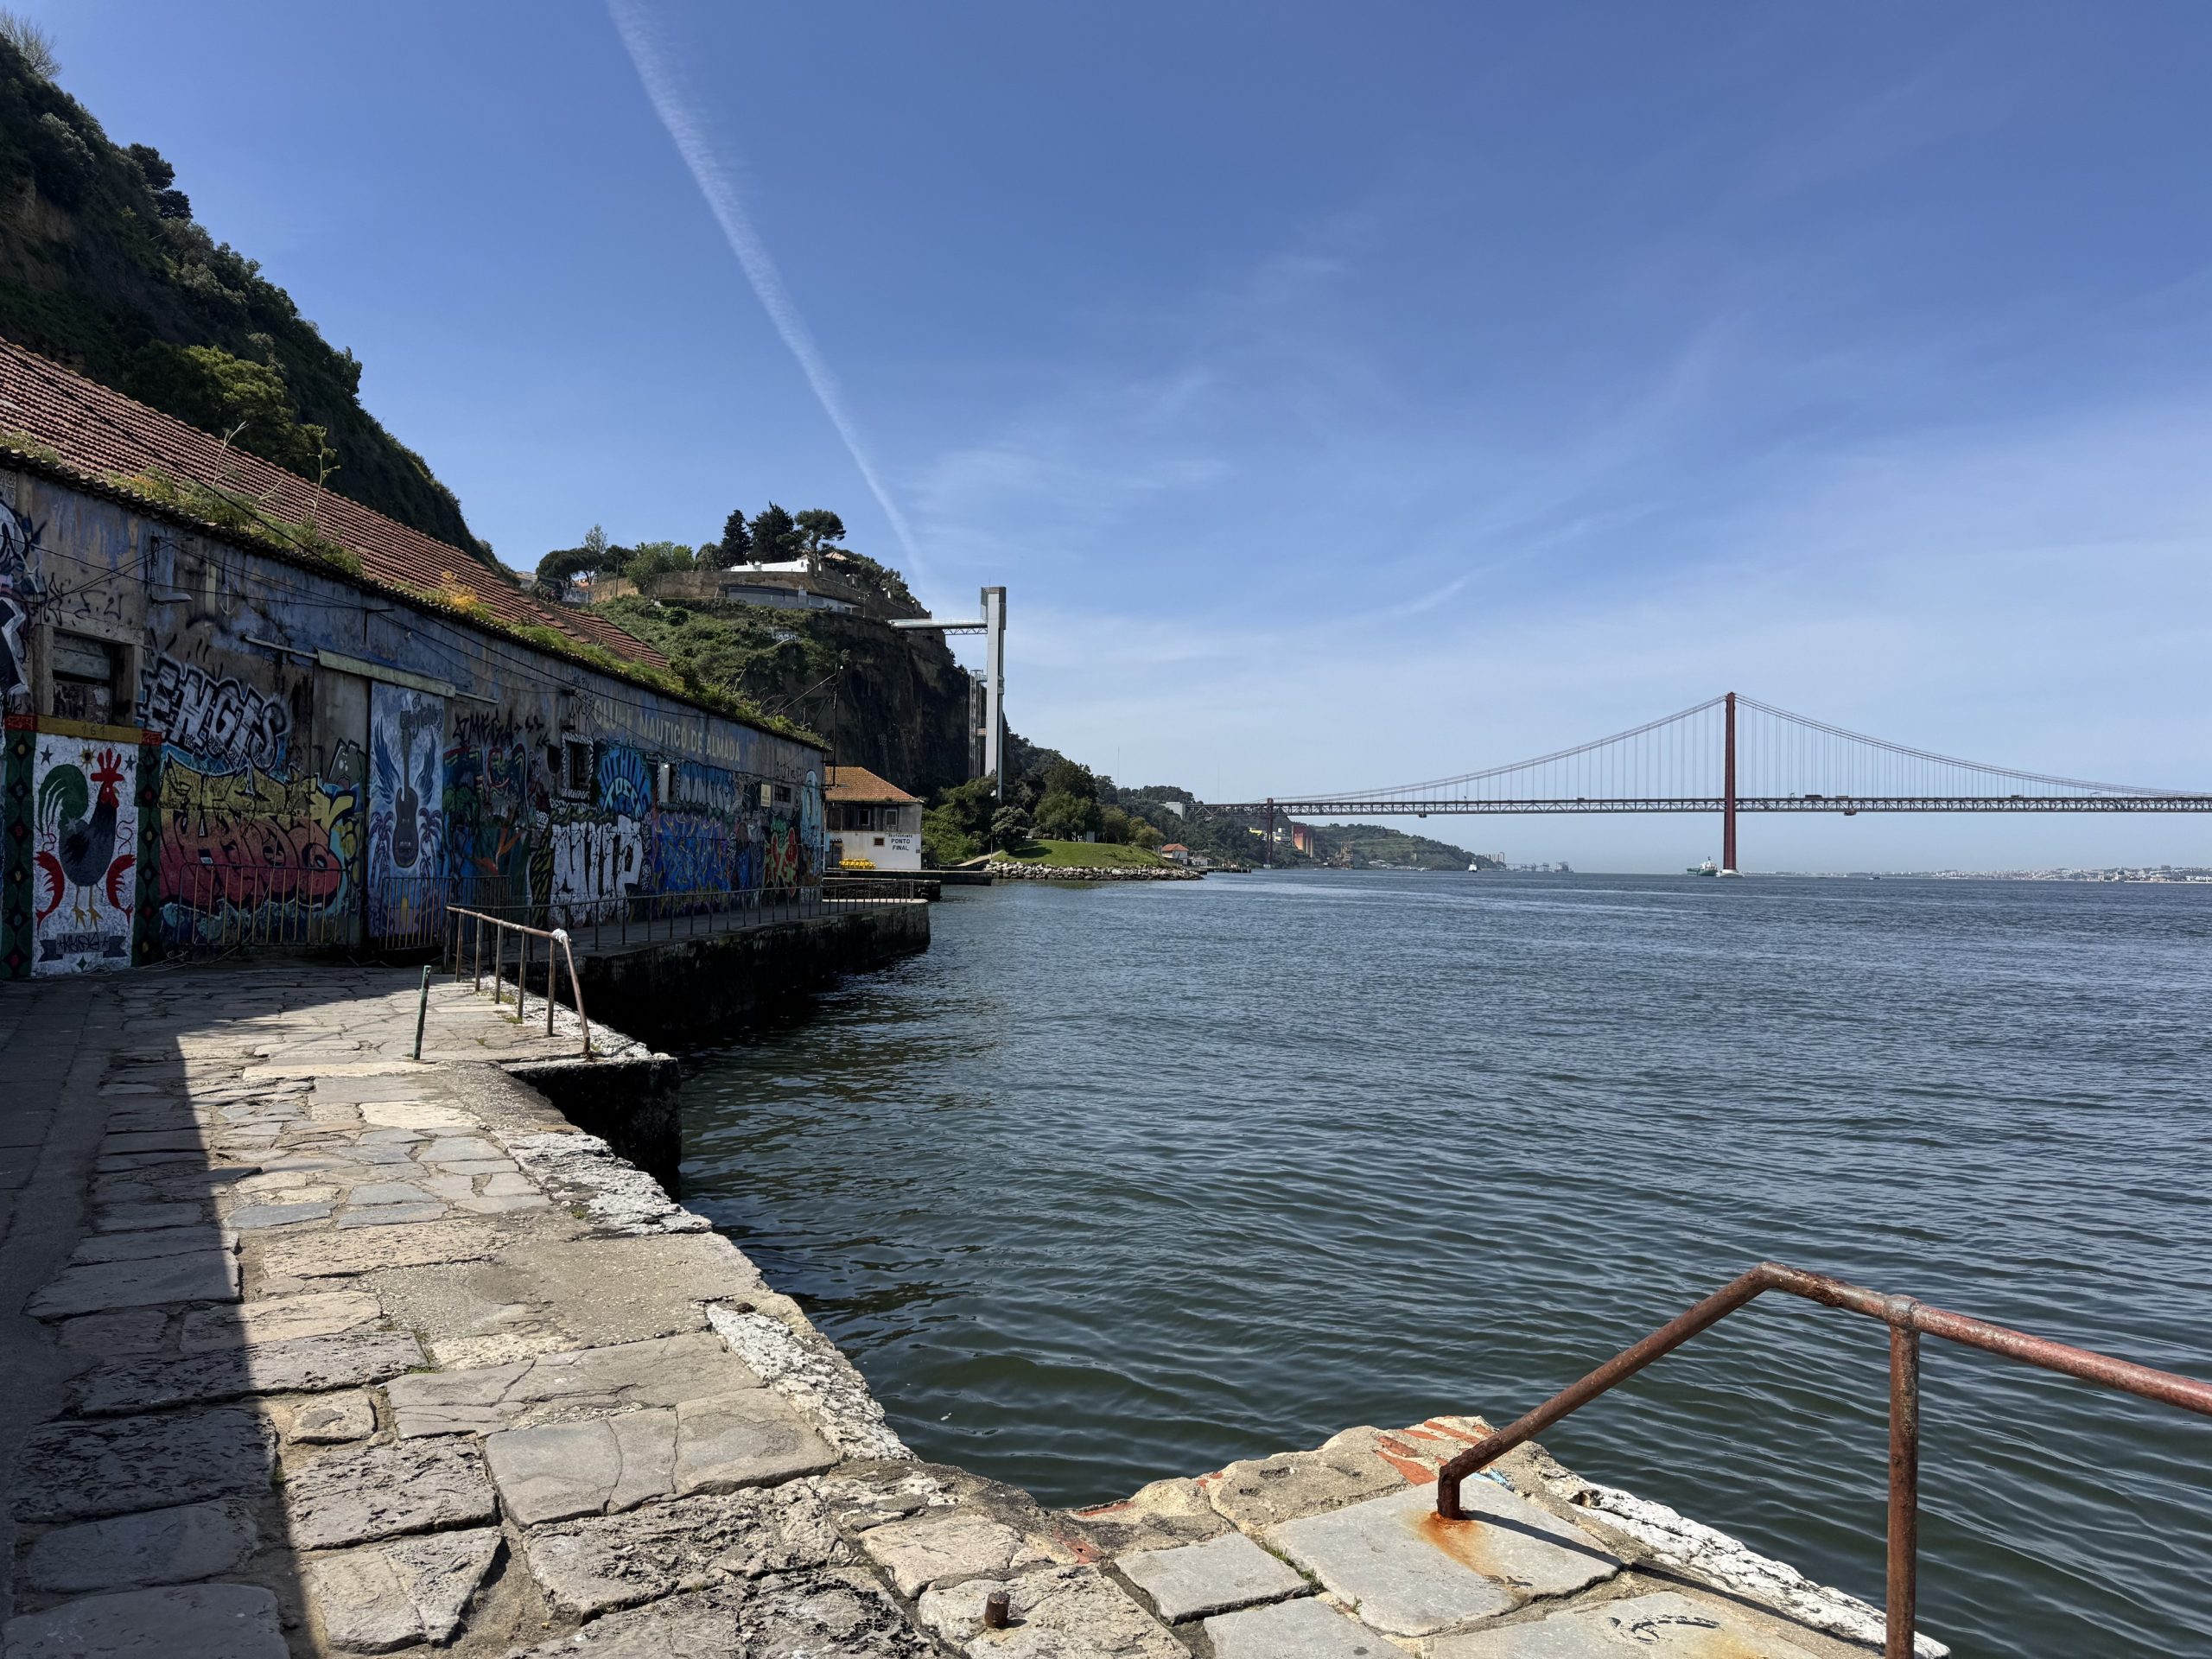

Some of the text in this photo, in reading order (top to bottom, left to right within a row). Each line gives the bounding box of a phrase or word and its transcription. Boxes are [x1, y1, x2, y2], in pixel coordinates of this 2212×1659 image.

[594, 699, 634, 734] CLUE
[691, 729, 703, 754] DE
[706, 734, 741, 762] ALMADA
